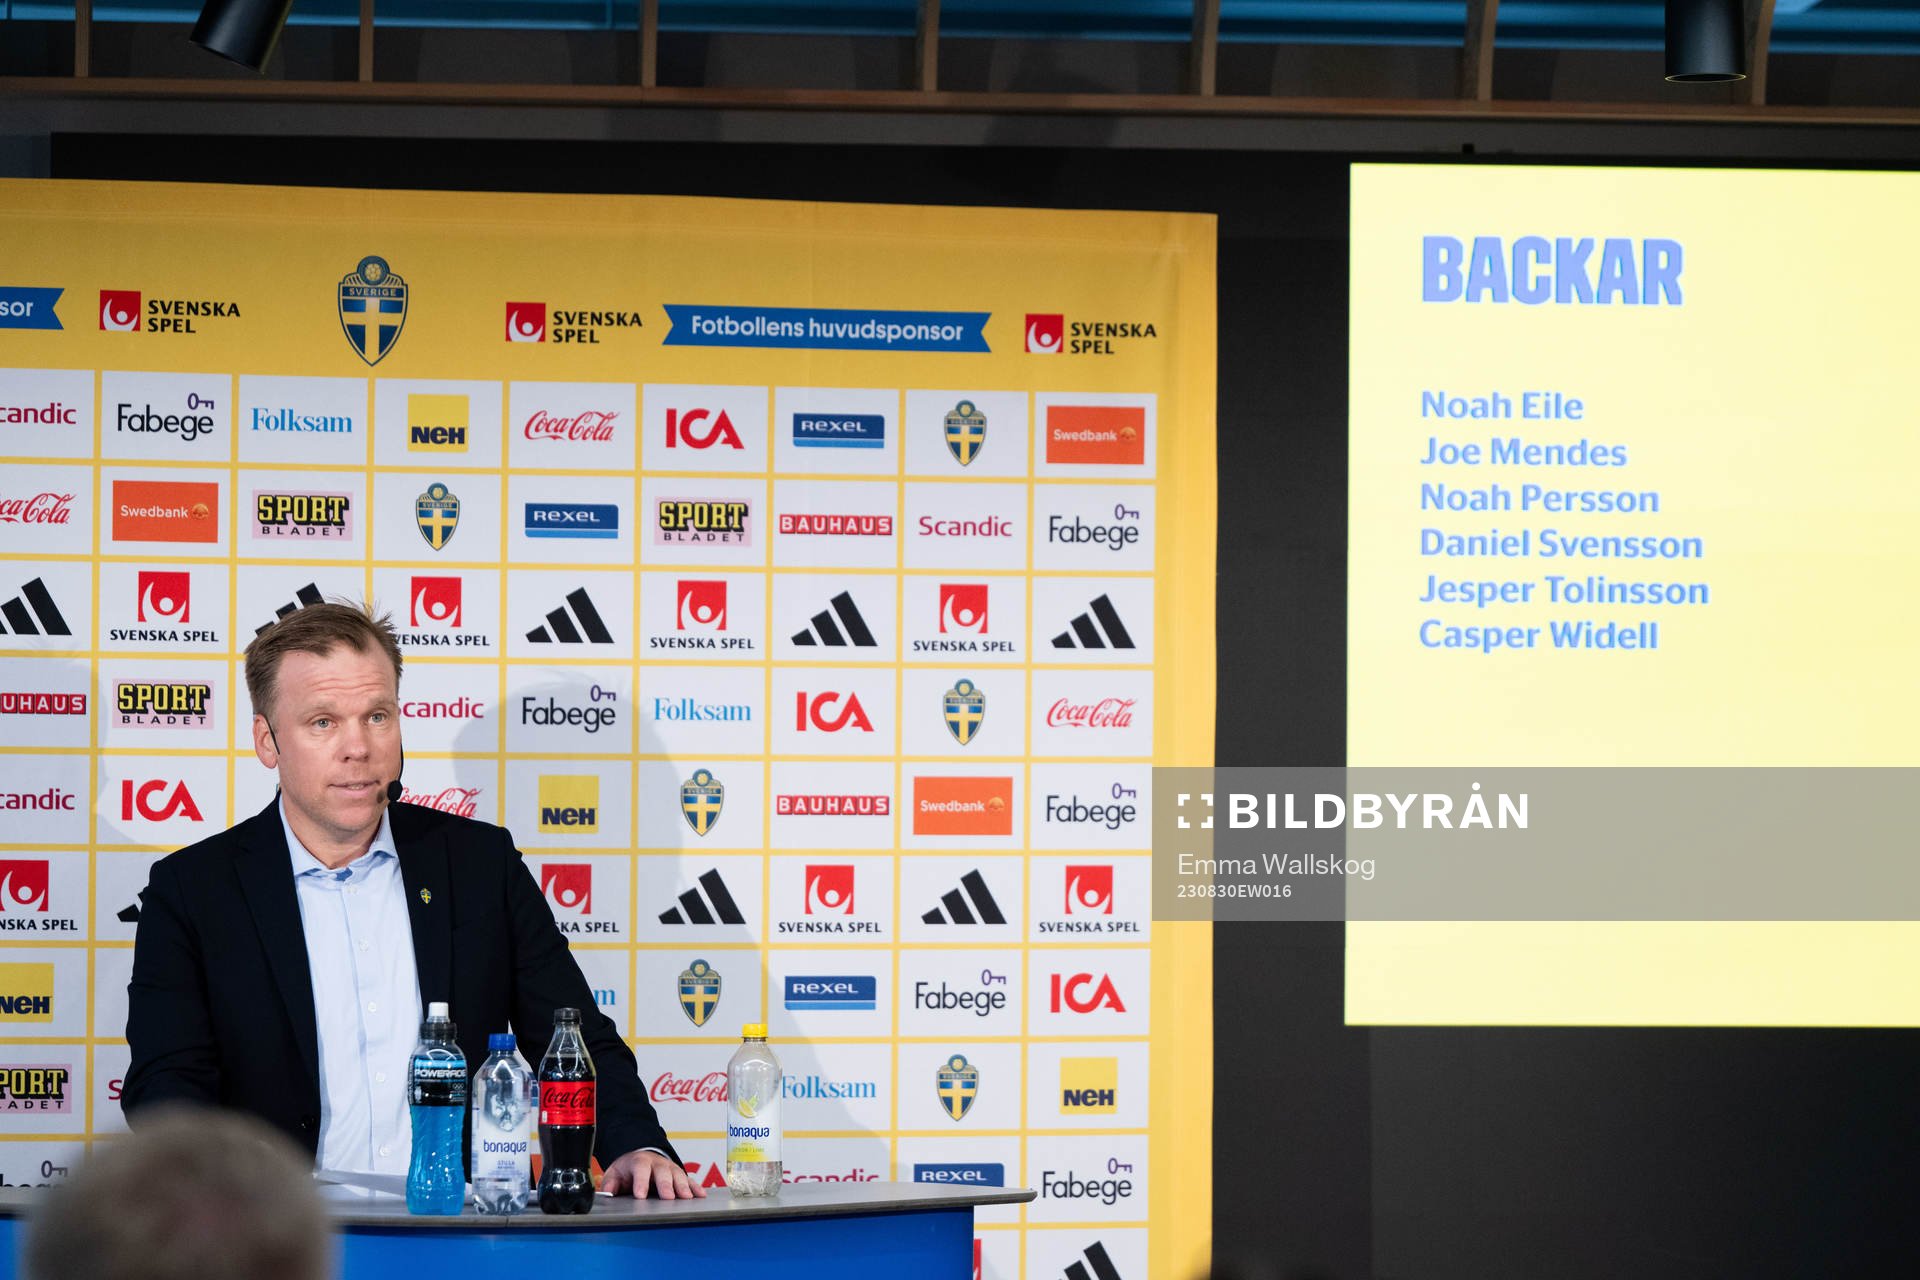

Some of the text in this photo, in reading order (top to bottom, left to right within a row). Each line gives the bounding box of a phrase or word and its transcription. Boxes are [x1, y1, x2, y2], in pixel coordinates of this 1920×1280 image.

[1422, 236, 1683, 305] BACKAR
[349, 287, 397, 297] SVERIGE
[148, 300, 241, 318] SVENSKA
[553, 311, 642, 327] SVENSKA
[148, 318, 197, 334] SPEL
[553, 329, 599, 343] SPEL
[692, 316, 963, 343] Fotbollens huvudsponsor
[1070, 322, 1157, 338] SVENSKA
[1070, 340, 1115, 355] SPEL
[1422, 390, 1584, 420] Noah Eile
[117, 404, 214, 441] Fabege
[253, 408, 351, 432] Folksam
[524, 411, 617, 441] Coca-Cola
[666, 408, 744, 449] ICA
[1054, 429, 1117, 441] Swedbank
[1421, 437, 1627, 467] Joe Mendes
[1421, 483, 1659, 512] Noah Persson
[121, 505, 188, 518] Swedbank
[257, 495, 349, 526] SPORT
[659, 501, 749, 531] SPORT
[262, 527, 344, 536] BLADET
[780, 514, 893, 535] BAUHAUS
[920, 516, 1012, 536] Scandic
[1049, 515, 1139, 550] Fabege
[664, 531, 744, 542] BLADET
[1421, 528, 1703, 559] Daniel Svensson
[1420, 575, 1709, 608] Jesper Tolinsson
[111, 630, 218, 641] SVENSKA SPEL
[456, 635, 489, 646] SPEL
[651, 638, 754, 648] SVENSKA SPEL
[914, 641, 1014, 651] SVENSKA SPEL
[1420, 619, 1657, 654] Casper Widell
[118, 684, 210, 715] SPORT
[399, 697, 484, 719] candic
[655, 698, 750, 720] Folksam
[122, 714, 206, 724] BLADET
[522, 697, 616, 733] Fabege
[797, 692, 874, 732] ICA
[1046, 698, 1137, 728] Coca-Cola
[122, 780, 203, 822] ICA
[777, 795, 890, 815] BAUHAUS
[921, 800, 984, 812] Swedbank
[1046, 796, 1136, 830] Fabege
[42, 919, 78, 930] SPEL
[585, 922, 619, 932] SPEL
[779, 922, 881, 932] SVENSKA SPEL
[1040, 922, 1139, 932] SVENSKA SPEL
[915, 982, 1006, 1016] Fabege
[1051, 973, 1126, 1013] ICA
[650, 1072, 728, 1102] Coca-Col
[782, 1076, 876, 1099] Folksam
[729, 1124, 770, 1140] bonaqua
[483, 1139, 527, 1155] bonaqua
[1042, 1171, 1132, 1205] Fabege
